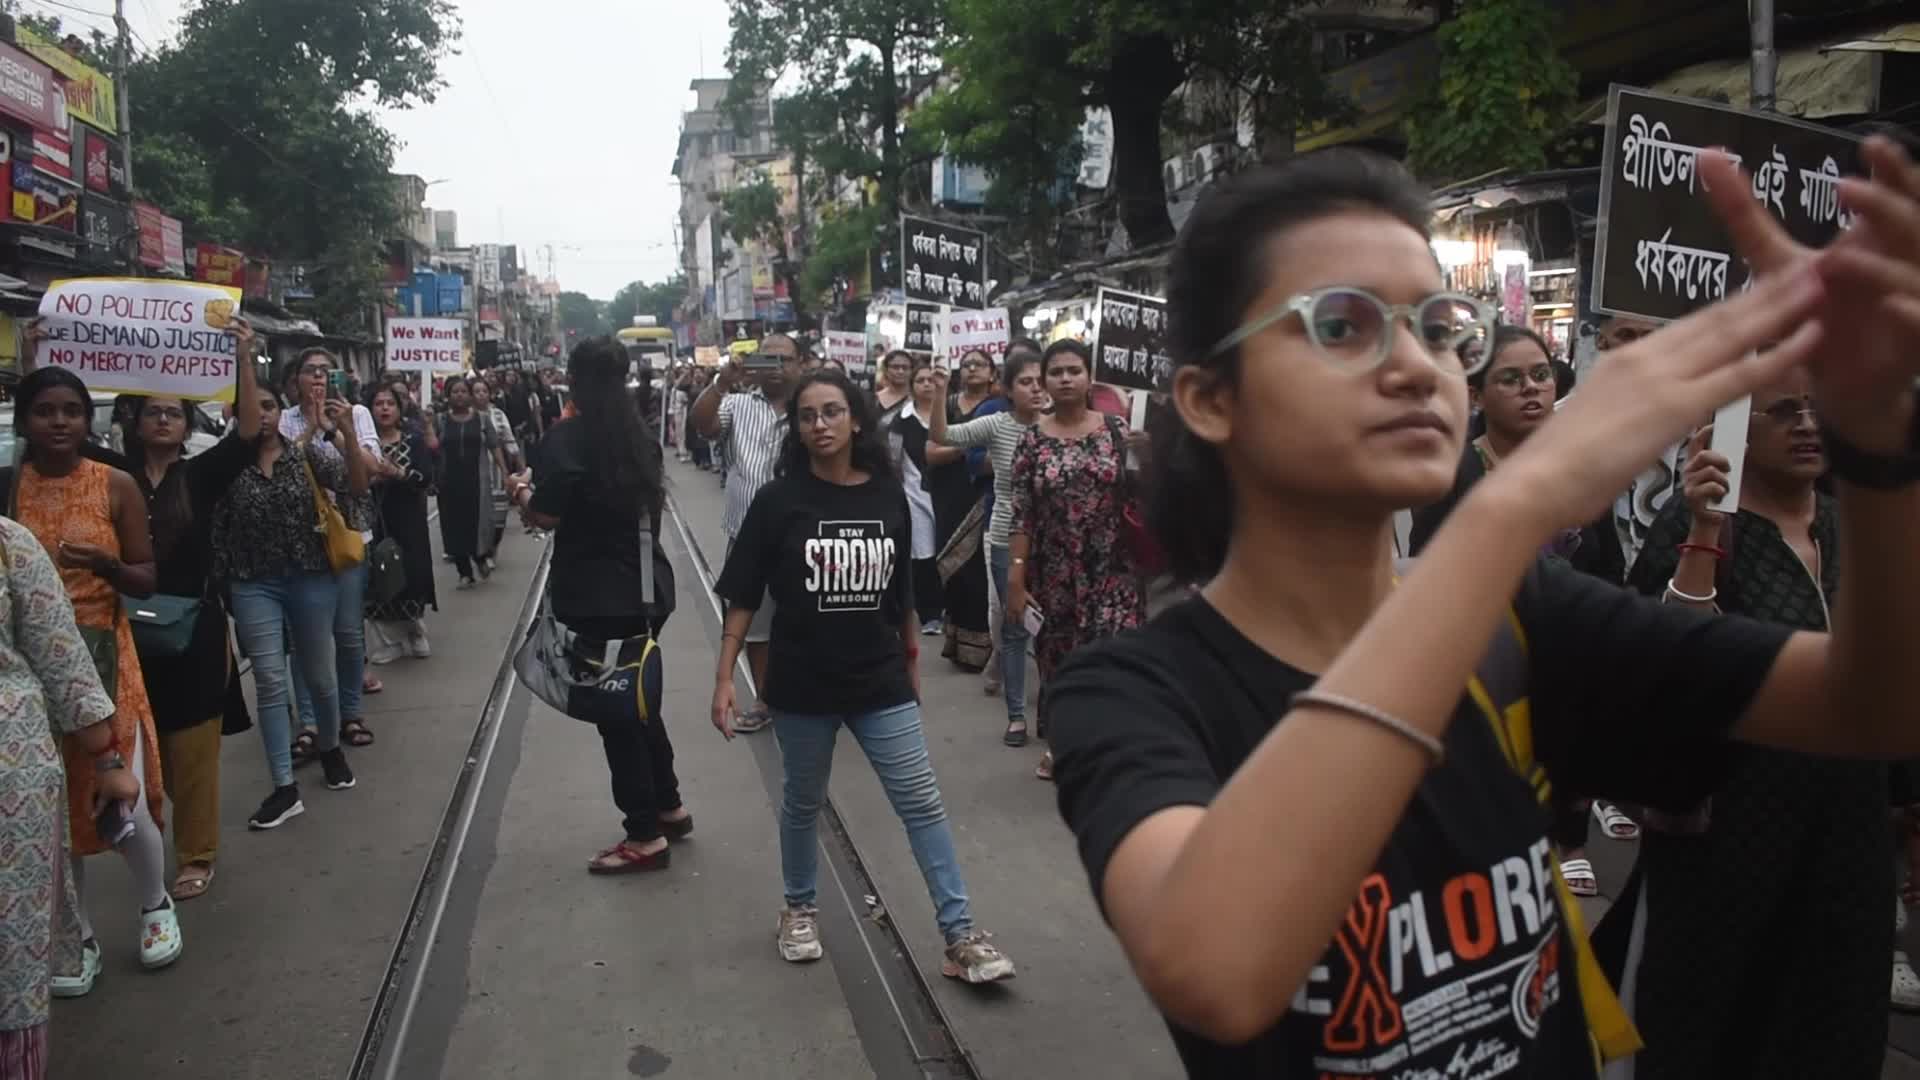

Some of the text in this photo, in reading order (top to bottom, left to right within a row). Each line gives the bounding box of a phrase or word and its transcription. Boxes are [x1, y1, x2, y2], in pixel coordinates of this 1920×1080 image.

[1753, 144, 1790, 219] এই
[1635, 227, 1730, 301] ধর্ষকদের
[56, 293, 193, 323] NO POLITICS
[72, 321, 159, 348] DEMAND
[164, 328, 236, 356] JUSTICE
[391, 326, 460, 340] We Want
[50, 347, 234, 376] NO MERCY TO RAPIST
[391, 349, 460, 363] JUSTICE
[839, 528, 864, 538] STAY
[805, 538, 895, 592] STRONG
[826, 594, 876, 603] AWESOME
